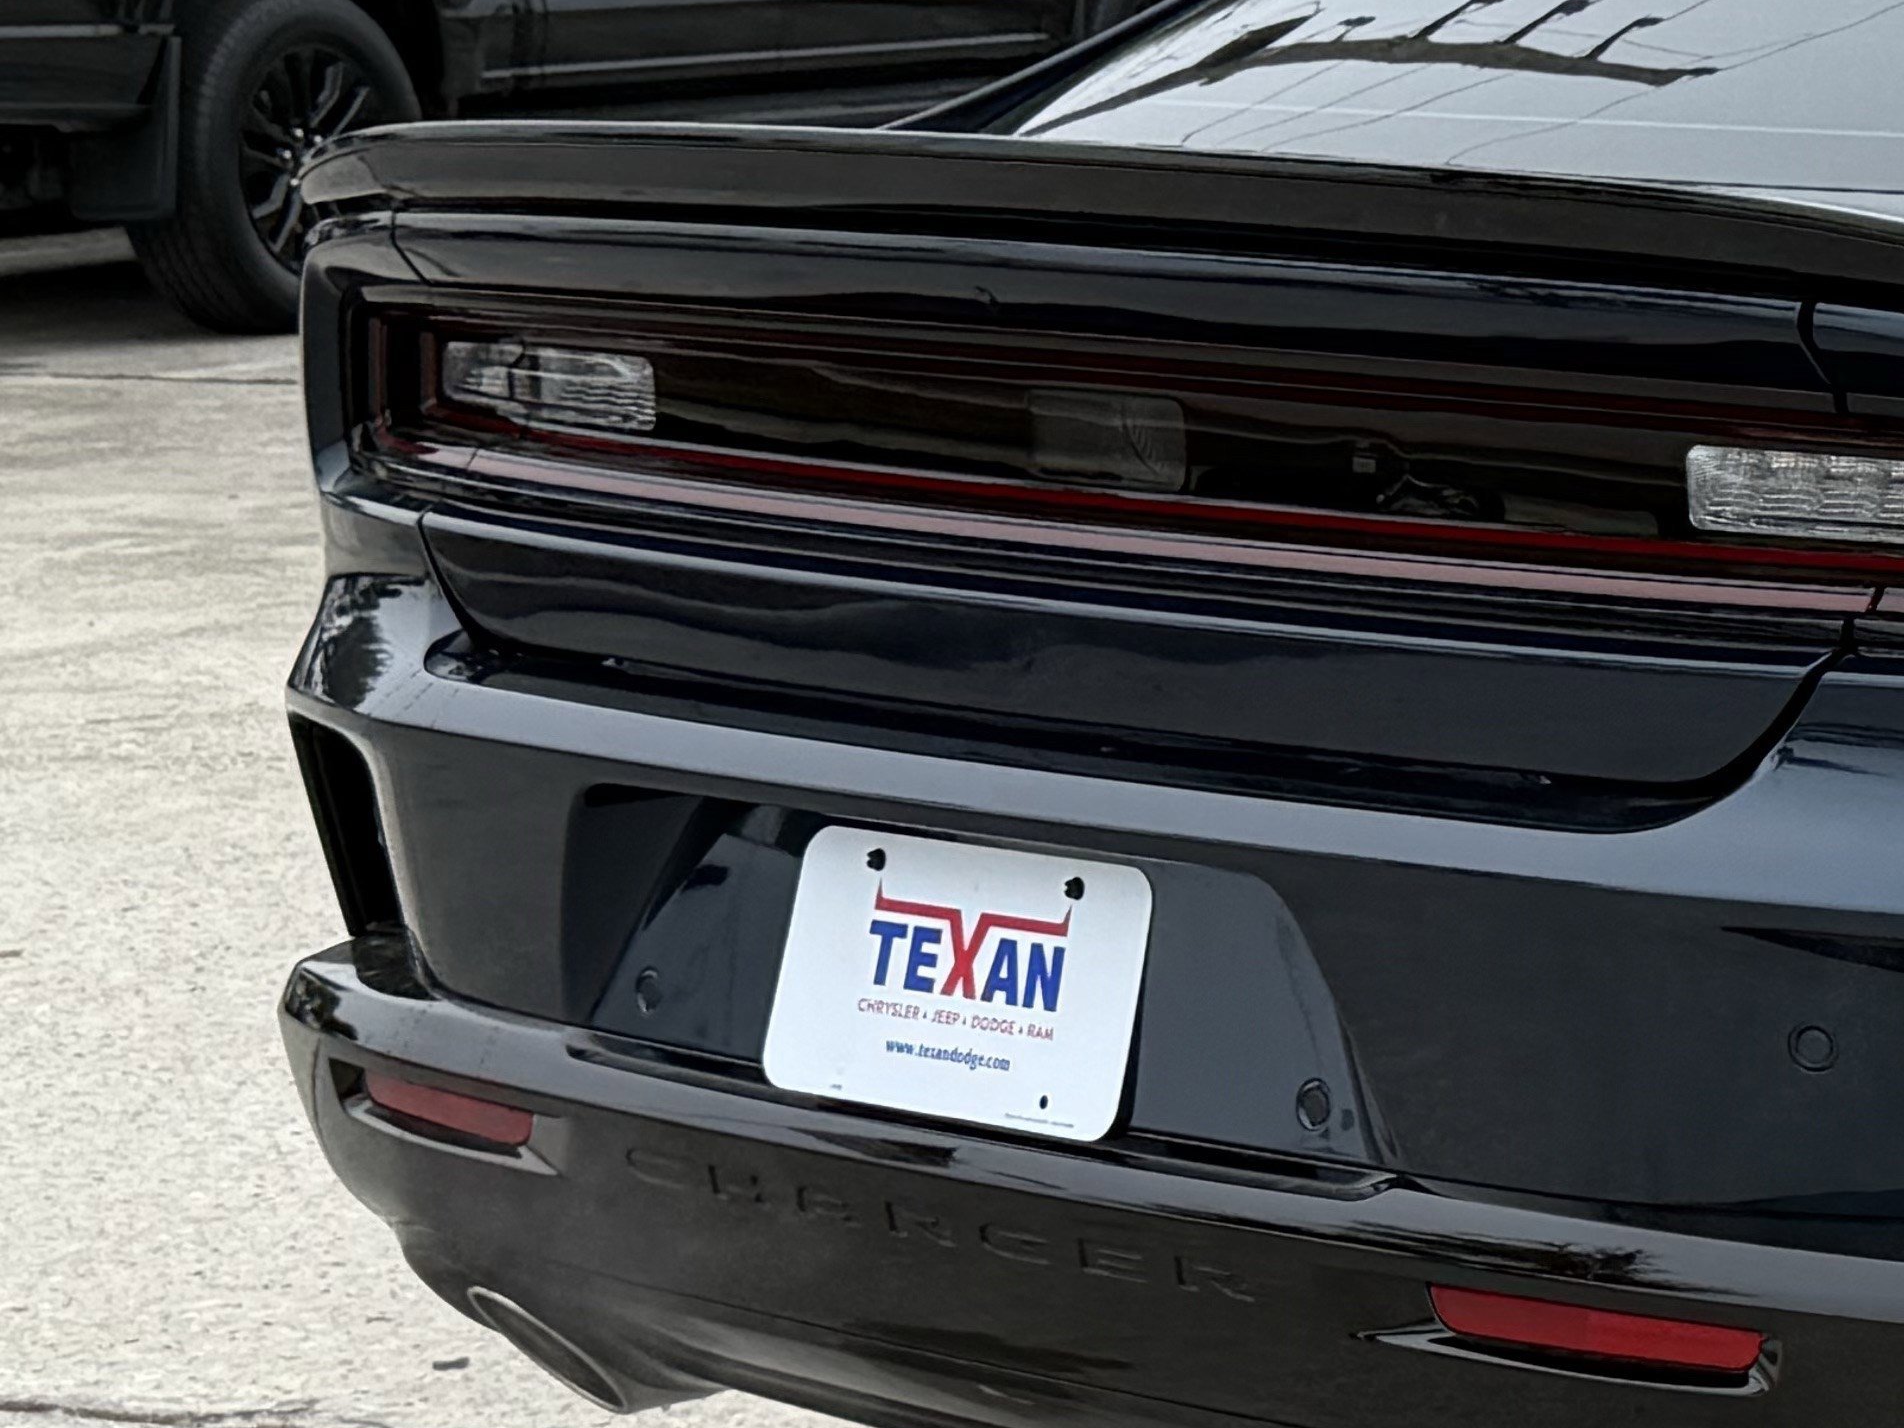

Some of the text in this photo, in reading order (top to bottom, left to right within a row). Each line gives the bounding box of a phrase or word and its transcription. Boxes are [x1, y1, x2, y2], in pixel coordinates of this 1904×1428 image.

[869, 897, 1068, 1012] TEXAN
[857, 997, 1054, 1041] CHRYSLER JEEP DODGE RAM
[886, 1039, 1010, 1071] www.texandodge.com
[623, 1146, 1256, 1302] CHARGER
